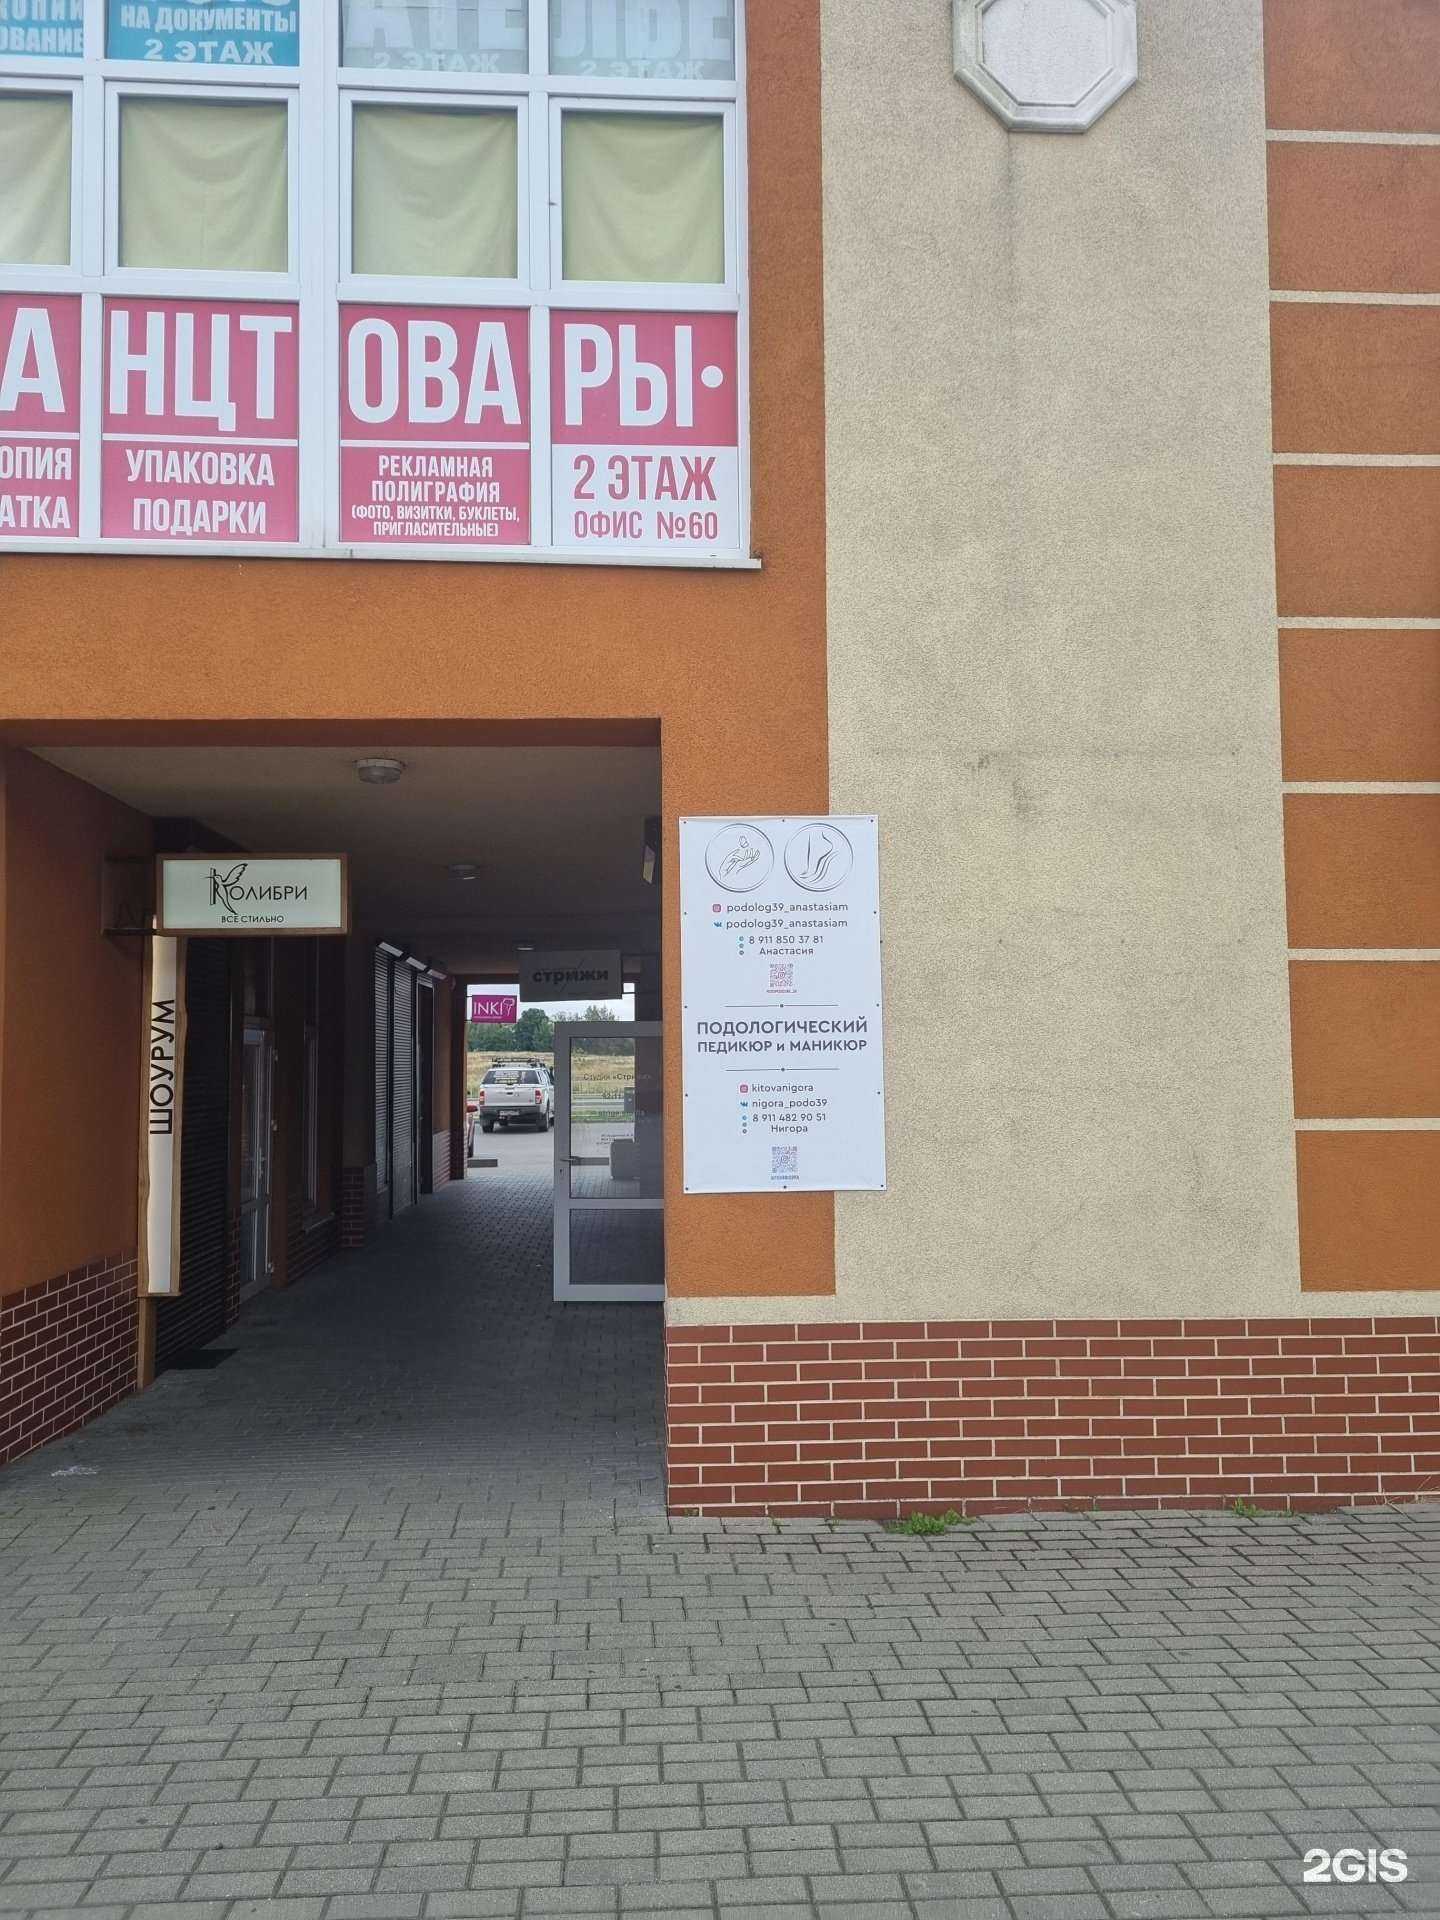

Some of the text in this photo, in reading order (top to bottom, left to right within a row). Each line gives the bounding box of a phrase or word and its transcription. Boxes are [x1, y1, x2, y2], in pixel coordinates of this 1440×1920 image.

[120, 5, 296, 33] НА ДОКУМЕНТЫ
[144, 39, 274, 64] 2 ЭТАЖ
[402, 53, 500, 72] ЭТАЖ
[610, 61, 705, 80] ЭТАЖ
[126, 449, 275, 486] УПАКОВКА
[378, 455, 493, 477] РЕКЛАМНАЯ
[573, 454, 718, 501] 2 ЭТАЖ
[371, 480, 501, 503] ПОЛИГРАФИЯ
[133, 498, 267, 535] ПОДАРКИ
[351, 505, 394, 520] (ФОТО,
[459, 507, 520, 522] БУКЛЕТЫ,
[373, 522, 499, 537] ПРИГЛАСИТЕЛЬНЫЕ)
[574, 510, 719, 540] ОФИС №60
[726, 901, 849, 914] podolog39_anastasiam
[221, 915, 285, 923] ВСЕ СТИЛЬНО
[726, 918, 848, 930] podolog39_anastasiam
[748, 935, 824, 945] 8 911 850 37 81
[759, 947, 814, 955] Анастасия
[697, 1016, 868, 1036] ПОДОЛОГИЧЕСКИЙ
[697, 1041, 773, 1054] ПЕДИКЮР
[789, 1040, 868, 1052] МАНИКЮР
[150, 1000, 175, 1134] ШОУРУМ
[751, 1083, 814, 1093] kitovanigora
[752, 1098, 828, 1109] nigora_podo39
[752, 1113, 827, 1122] 8 911 482 90 51
[771, 1125, 809, 1134] Нигора
